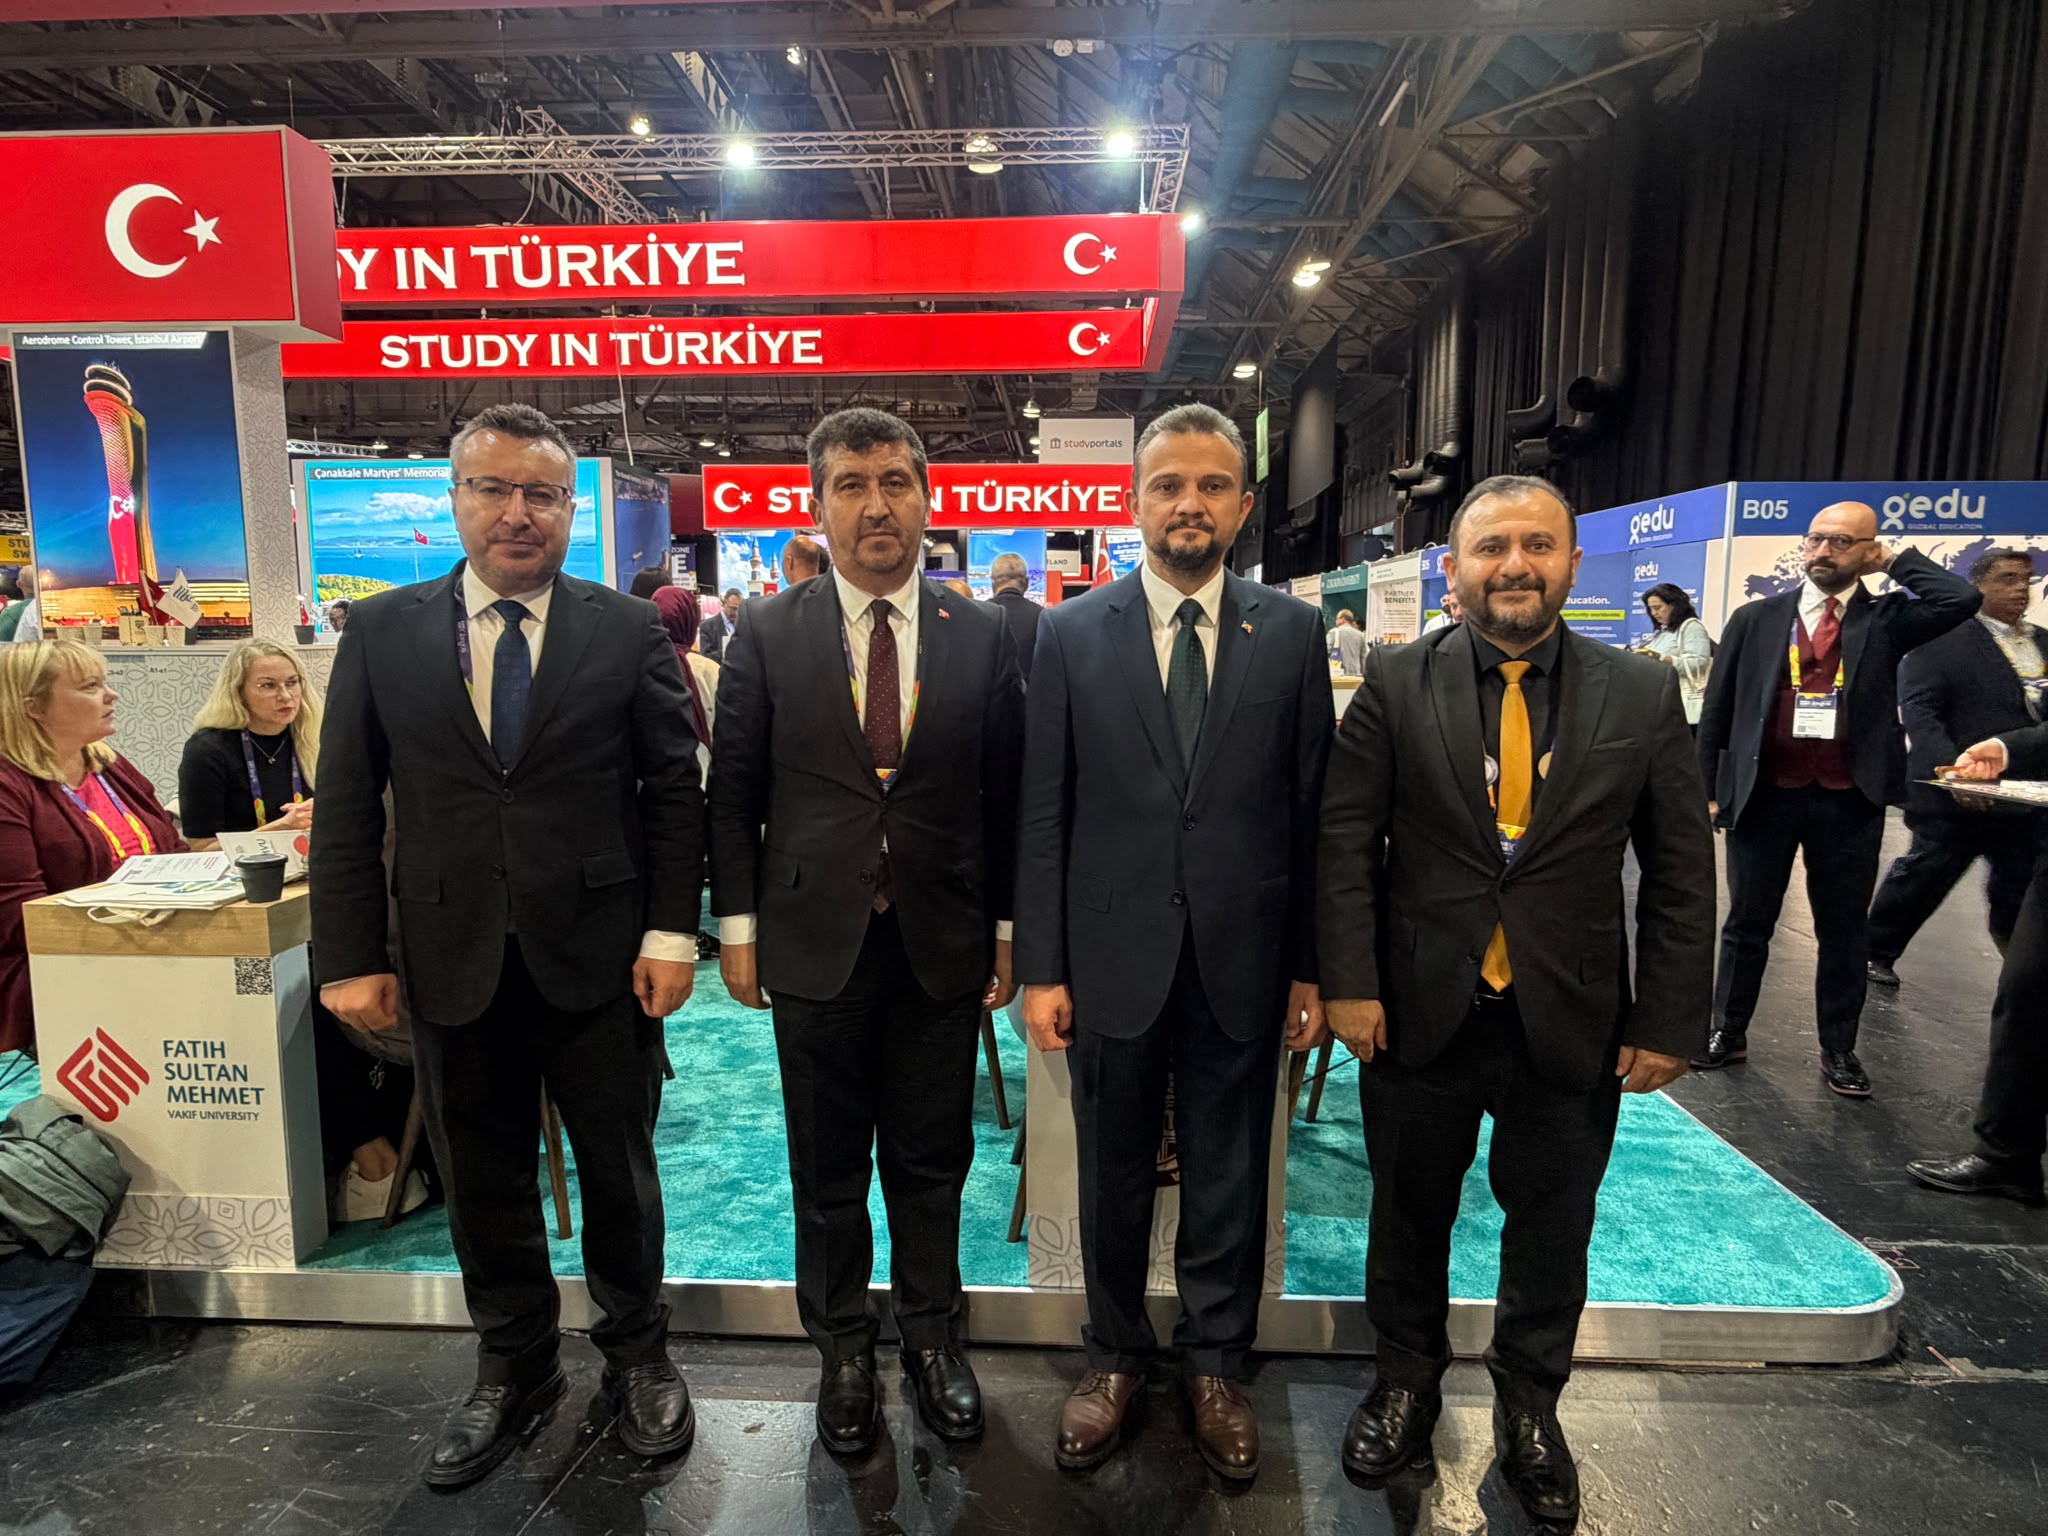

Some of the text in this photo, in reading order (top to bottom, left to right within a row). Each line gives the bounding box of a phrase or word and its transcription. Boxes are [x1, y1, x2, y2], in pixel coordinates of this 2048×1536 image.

[338, 232, 746, 291] Y IN TÜRKİYE
[22, 335, 70, 345] Aerodrome
[71, 334, 103, 344] Control
[104, 334, 133, 345] Tower,
[171, 334, 202, 346] Airport
[380, 322, 823, 369] STUDY IN TÜRKİYE
[1064, 439, 1123, 449] studyportals
[314, 468, 361, 480] Çanakkale
[404, 467, 449, 478] Memorial
[767, 485, 814, 514] ST
[951, 479, 1122, 514] TÜRKİYE
[1742, 499, 1789, 520] B05
[1881, 488, 1986, 530] gedu
[162, 1039, 226, 1059] FATIH
[164, 1062, 248, 1082] SULTAN
[167, 1085, 265, 1105] MEHMET
[167, 1110, 260, 1121] VAKIF UNIVERSITY
